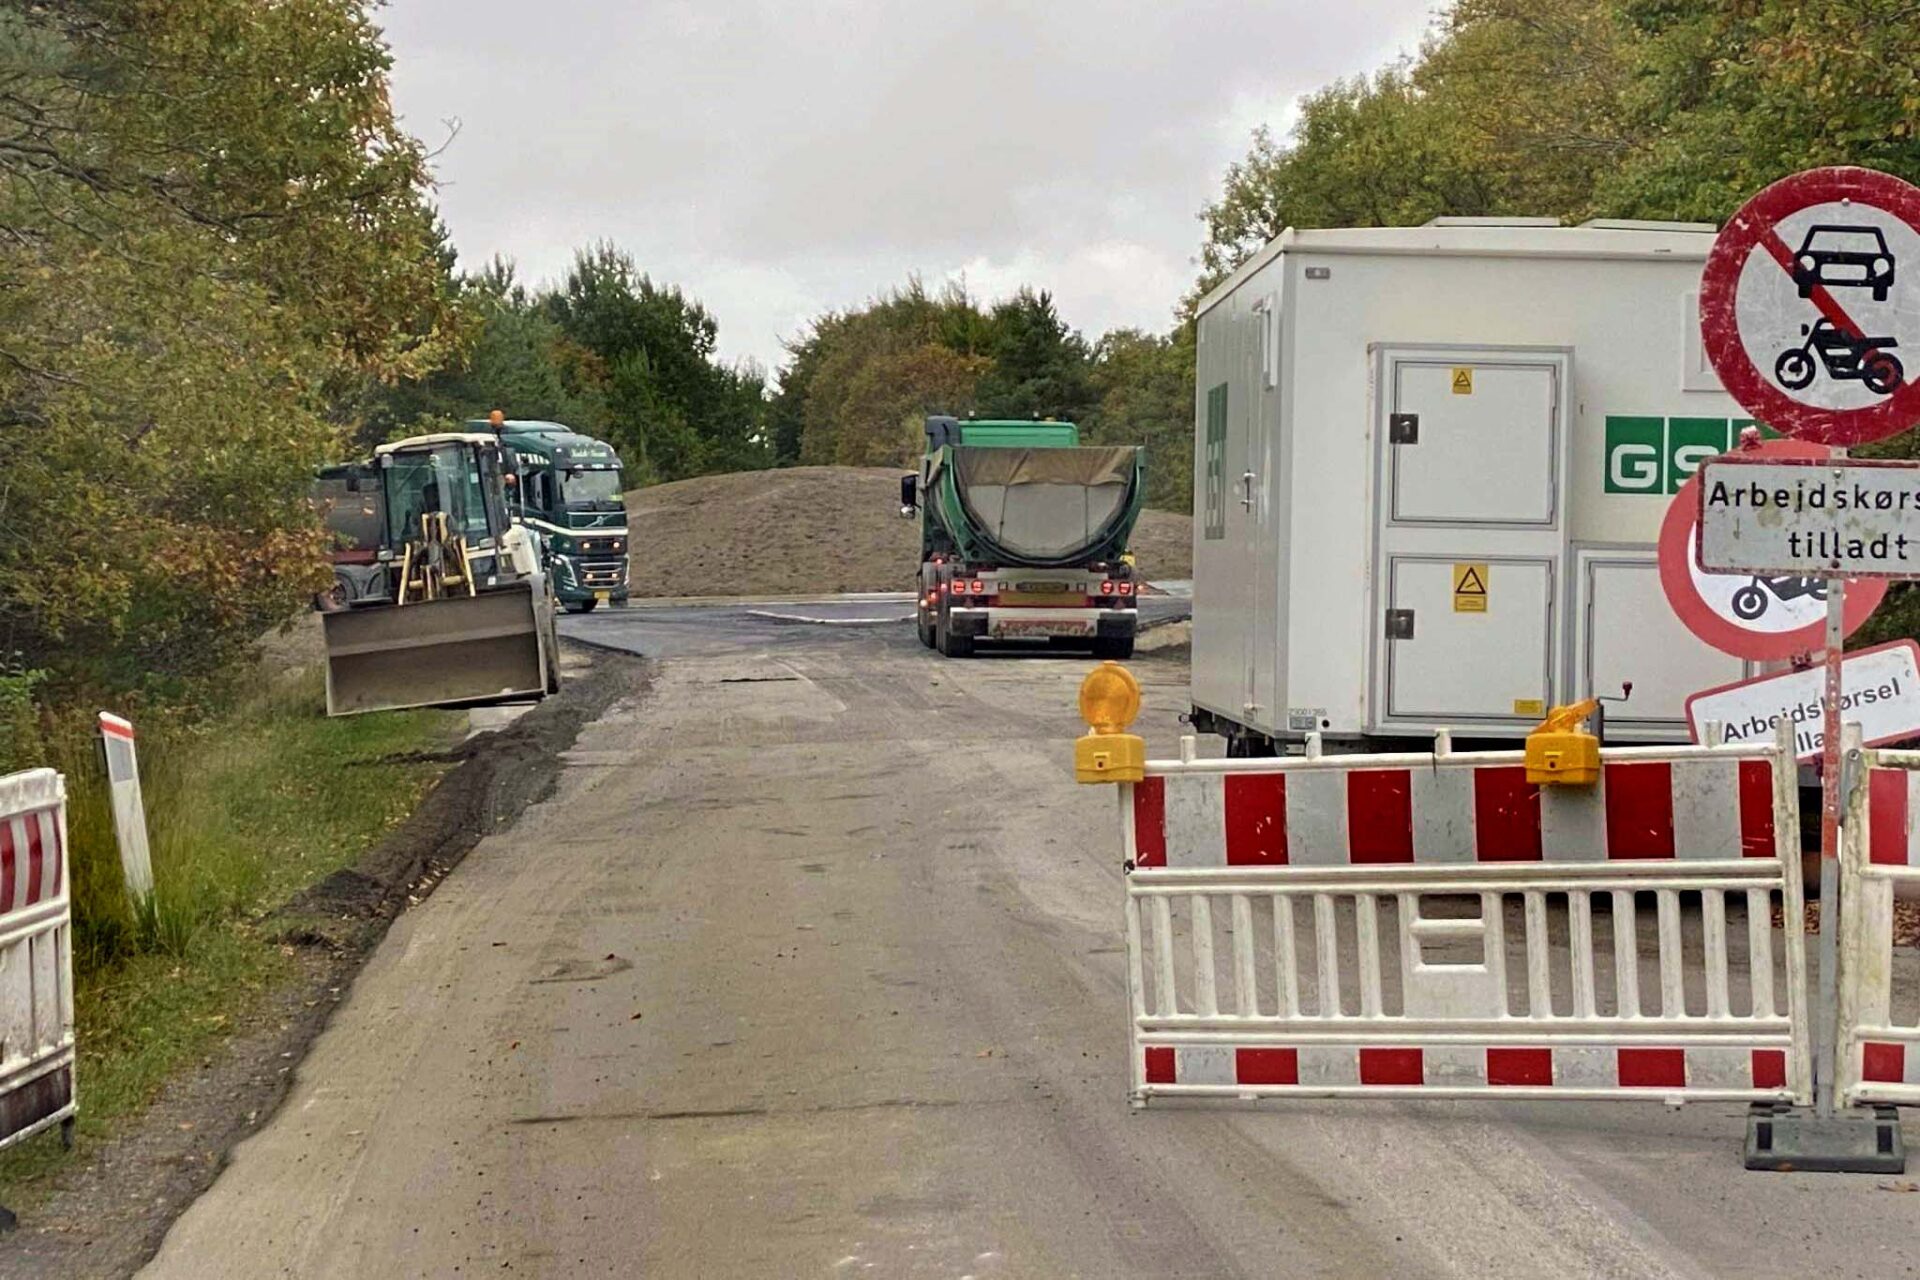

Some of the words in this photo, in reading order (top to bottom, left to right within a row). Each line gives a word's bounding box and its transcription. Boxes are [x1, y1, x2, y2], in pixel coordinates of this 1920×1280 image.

[1611, 443, 1719, 489] GS
[1788, 531, 1908, 560] tilladt
[1724, 677, 1901, 743] Arbedsørsel
